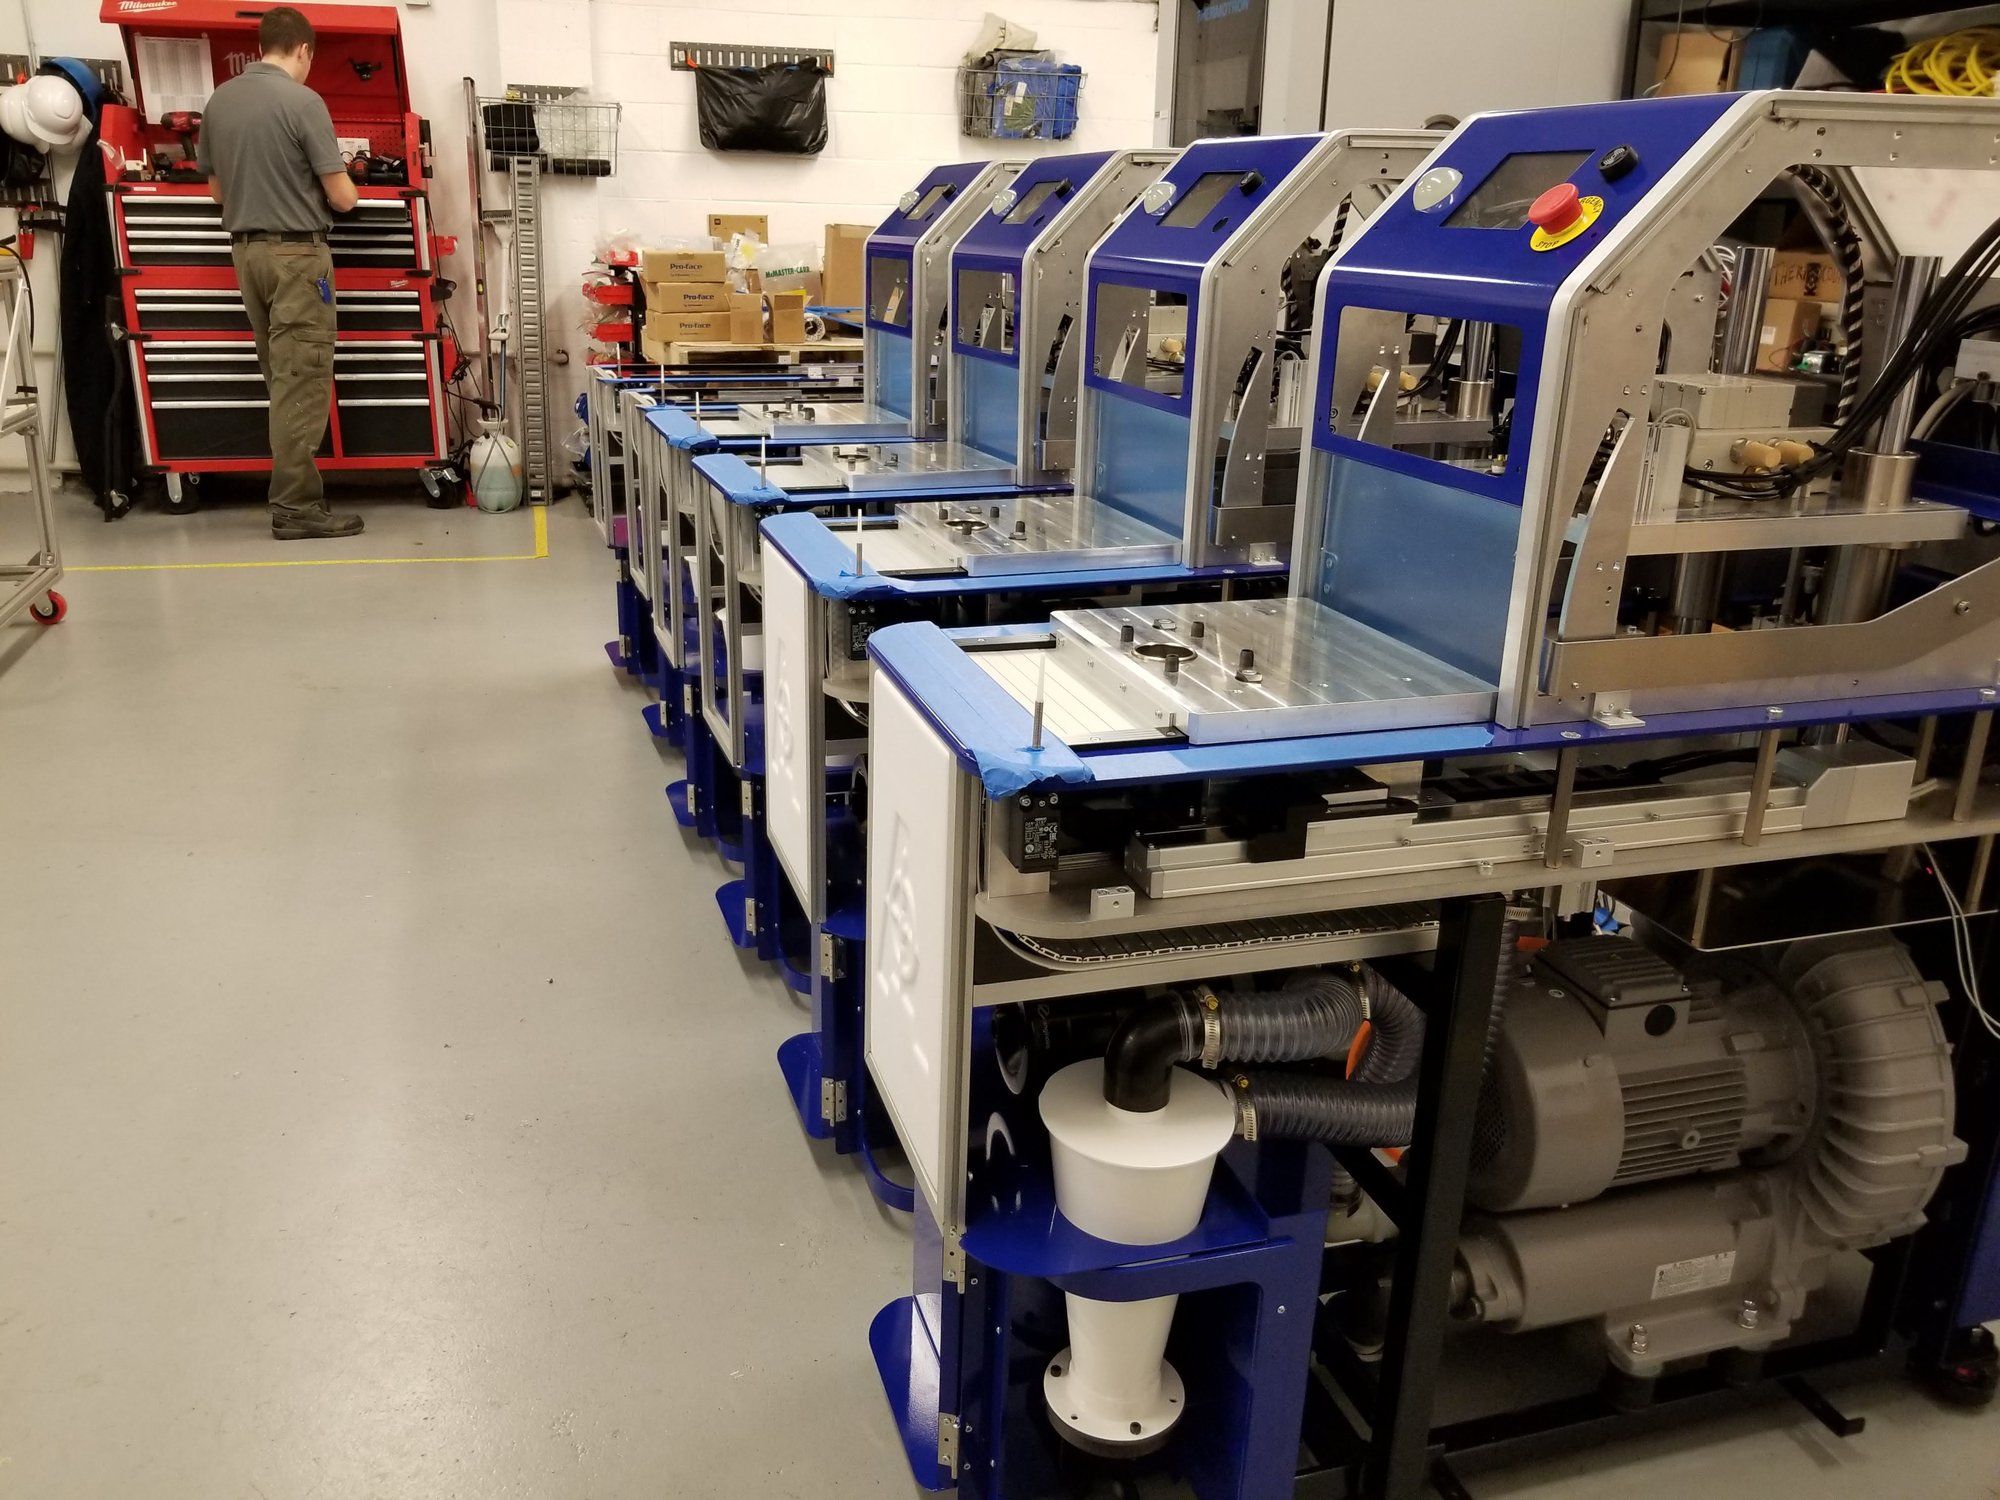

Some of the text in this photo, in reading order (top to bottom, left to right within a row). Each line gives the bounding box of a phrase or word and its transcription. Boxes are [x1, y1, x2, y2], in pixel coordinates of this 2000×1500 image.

[117, 1, 177, 10] Milwaukee
[1580, 197, 1603, 214] RGENCY
[1536, 240, 1559, 249] STOP
